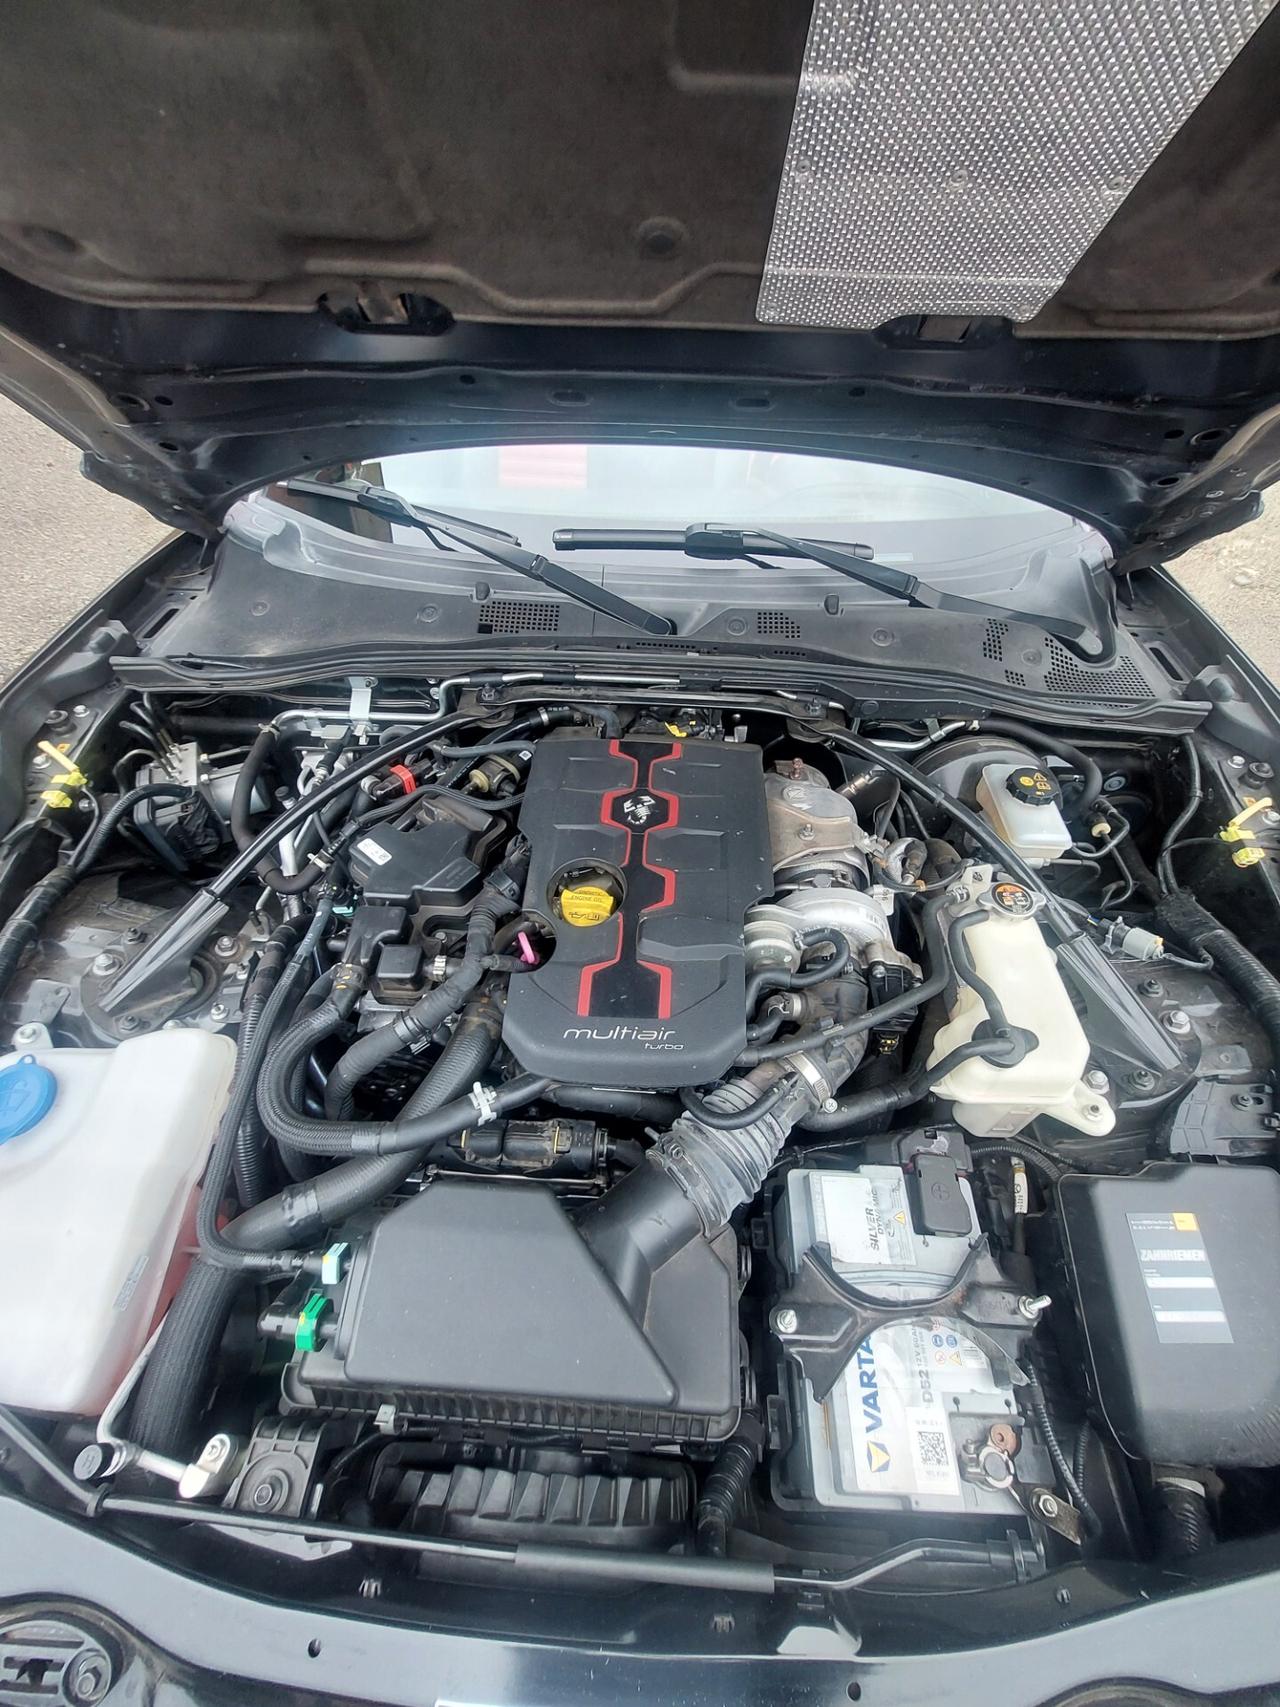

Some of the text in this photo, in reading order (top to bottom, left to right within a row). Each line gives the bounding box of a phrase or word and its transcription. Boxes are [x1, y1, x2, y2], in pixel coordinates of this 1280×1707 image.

[563, 1025, 676, 1040] multiair
[644, 1042, 684, 1051] turbo
[865, 1207, 880, 1251] SILVER
[856, 1335, 883, 1434] VARTA
